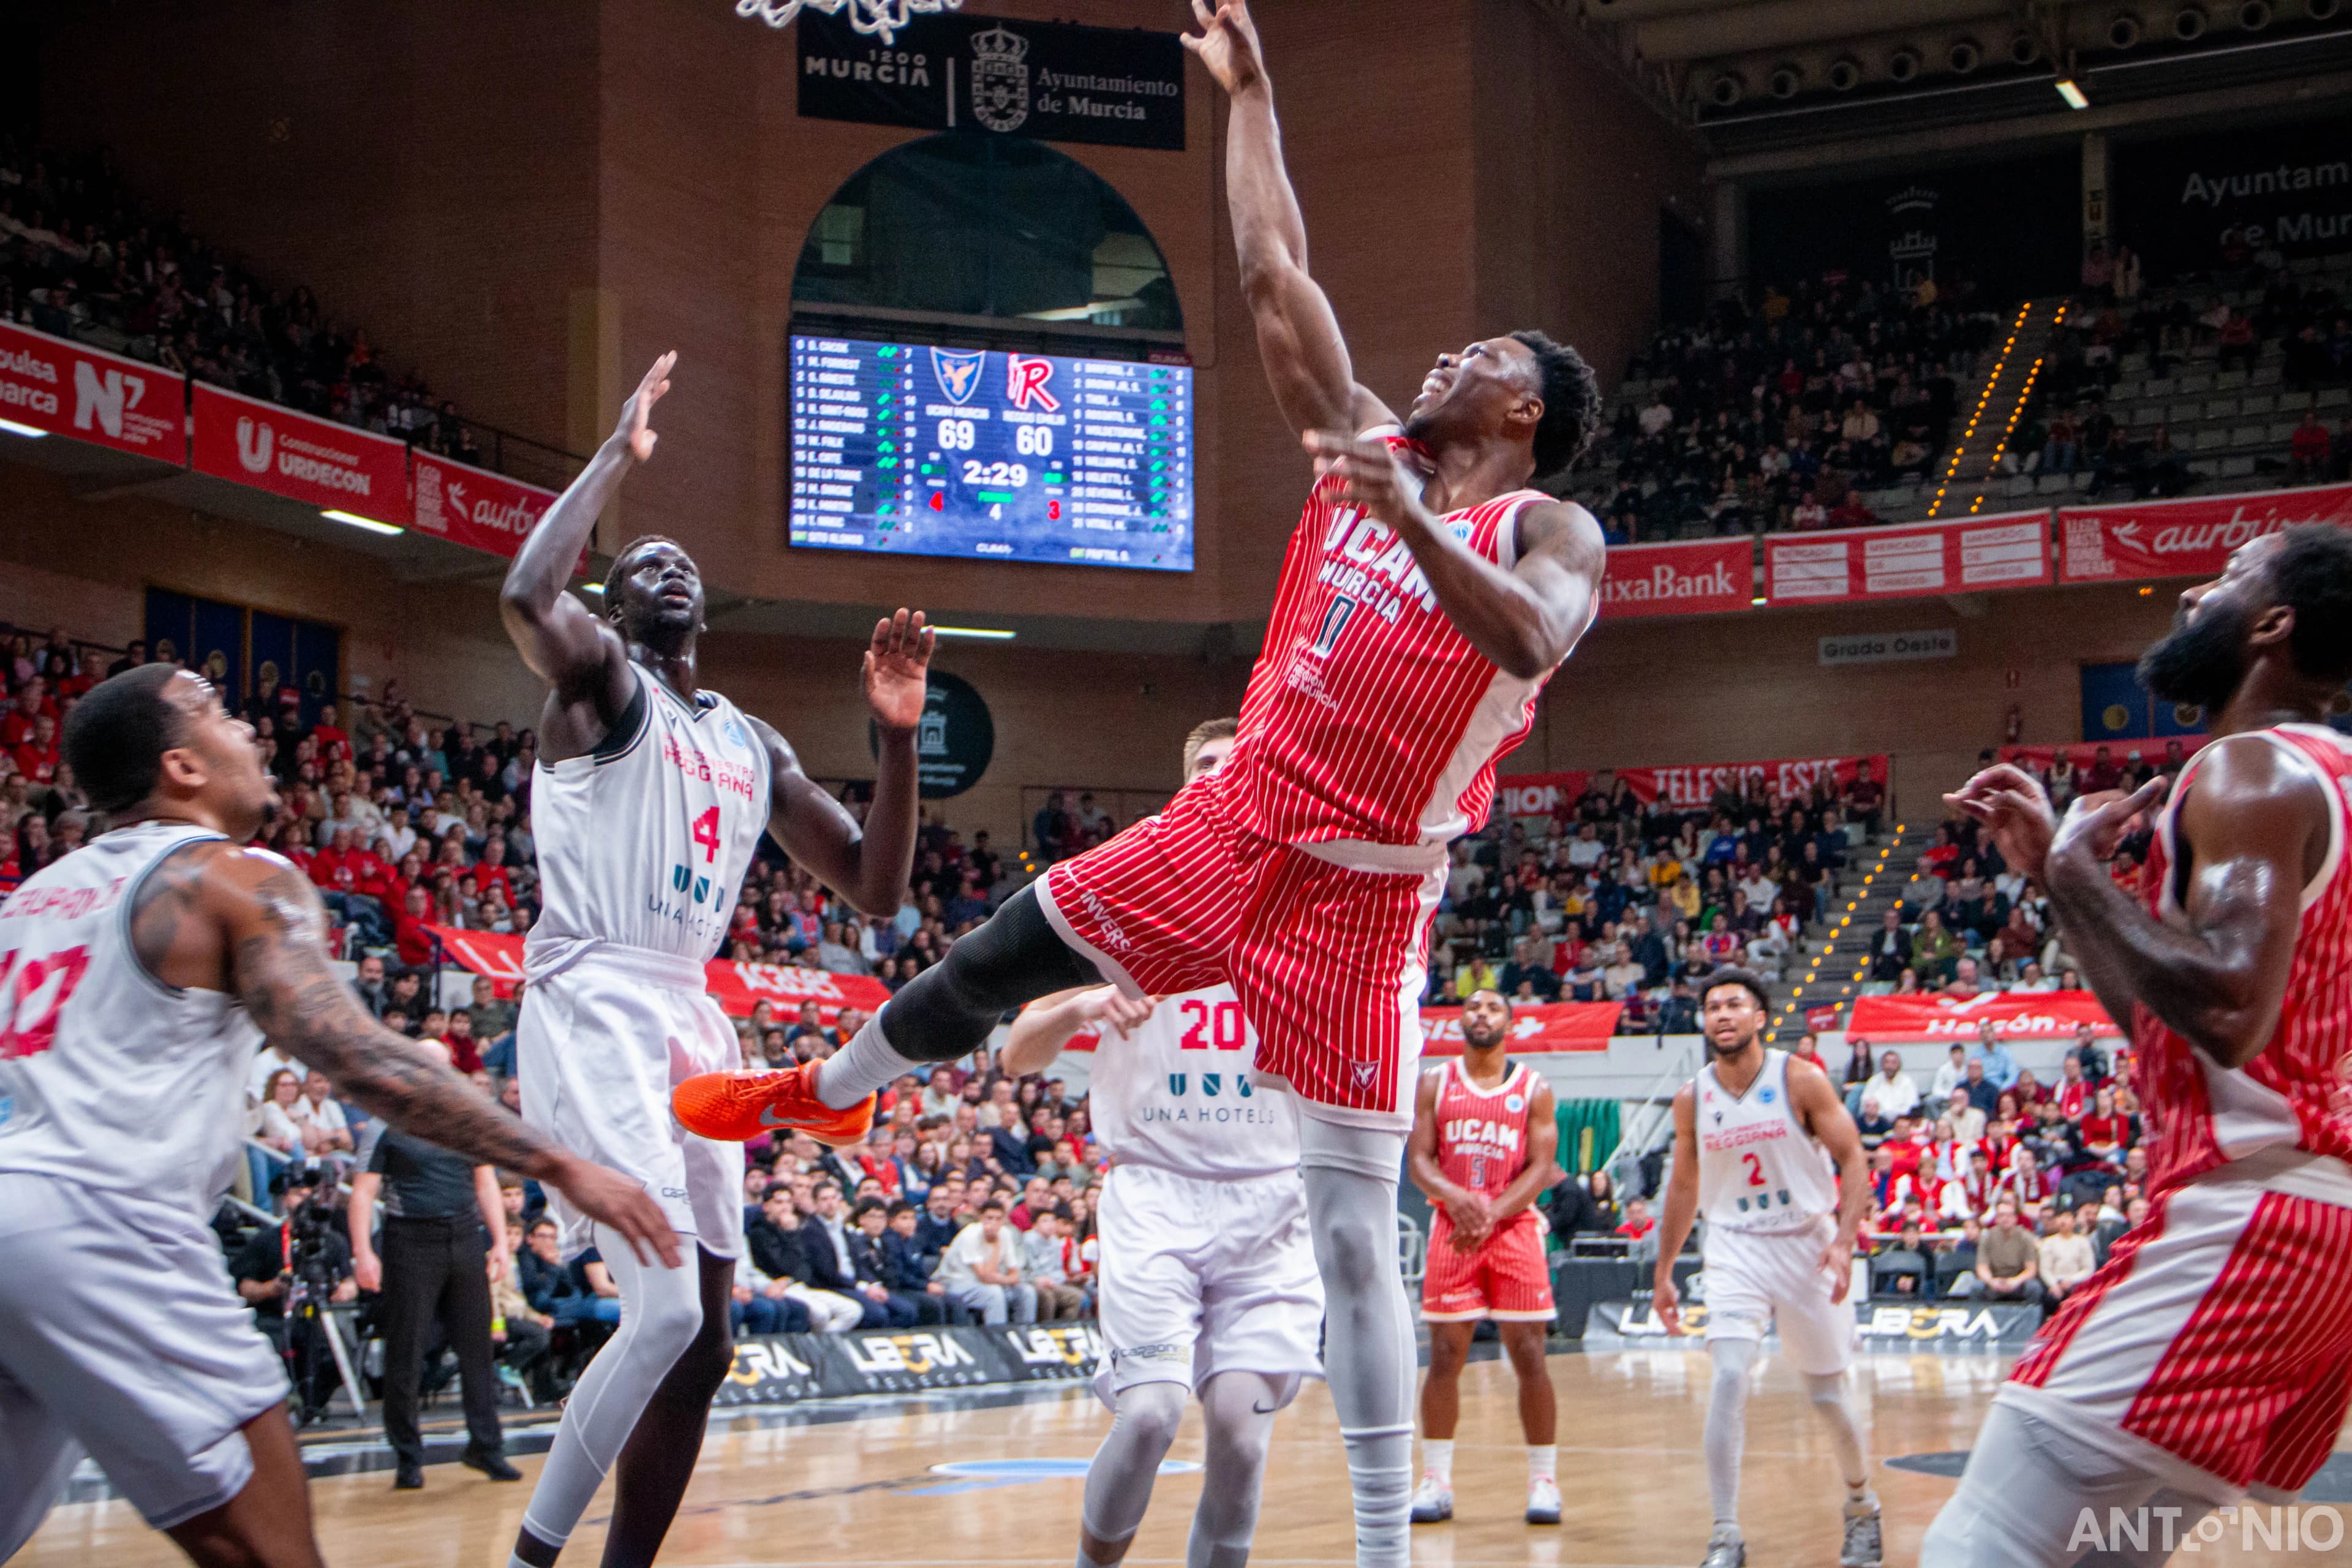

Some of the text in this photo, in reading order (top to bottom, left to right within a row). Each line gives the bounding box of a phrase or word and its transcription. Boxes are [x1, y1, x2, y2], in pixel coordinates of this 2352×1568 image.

[805, 56, 930, 86] MURCIA
[869, 49, 927, 66] 1200
[1036, 67, 1178, 97] Ayuntamiento
[1036, 93, 1146, 120] de Murcia
[938, 418, 975, 450] 69
[1016, 424, 1053, 456] 60
[278, 451, 371, 496] URDECON
[962, 460, 1028, 488] 2:29
[929, 491, 944, 513] 4
[989, 503, 1002, 521] 4
[1047, 500, 1061, 521] 3
[1322, 506, 1438, 614] UCAM
[1317, 559, 1401, 625] MURCIA
[1313, 592, 1357, 659] 0
[1825, 636, 1951, 658] Grada Oeste
[1299, 680, 1337, 712] MURCIA
[693, 805, 720, 864] 4
[1180, 999, 1246, 1051] 20
[1143, 1107, 1275, 1131] UNA HOTELS
[1446, 1118, 1519, 1152] UCAM
[1454, 1142, 1506, 1161] MURCIA
[1741, 1152, 1767, 1186] 2
